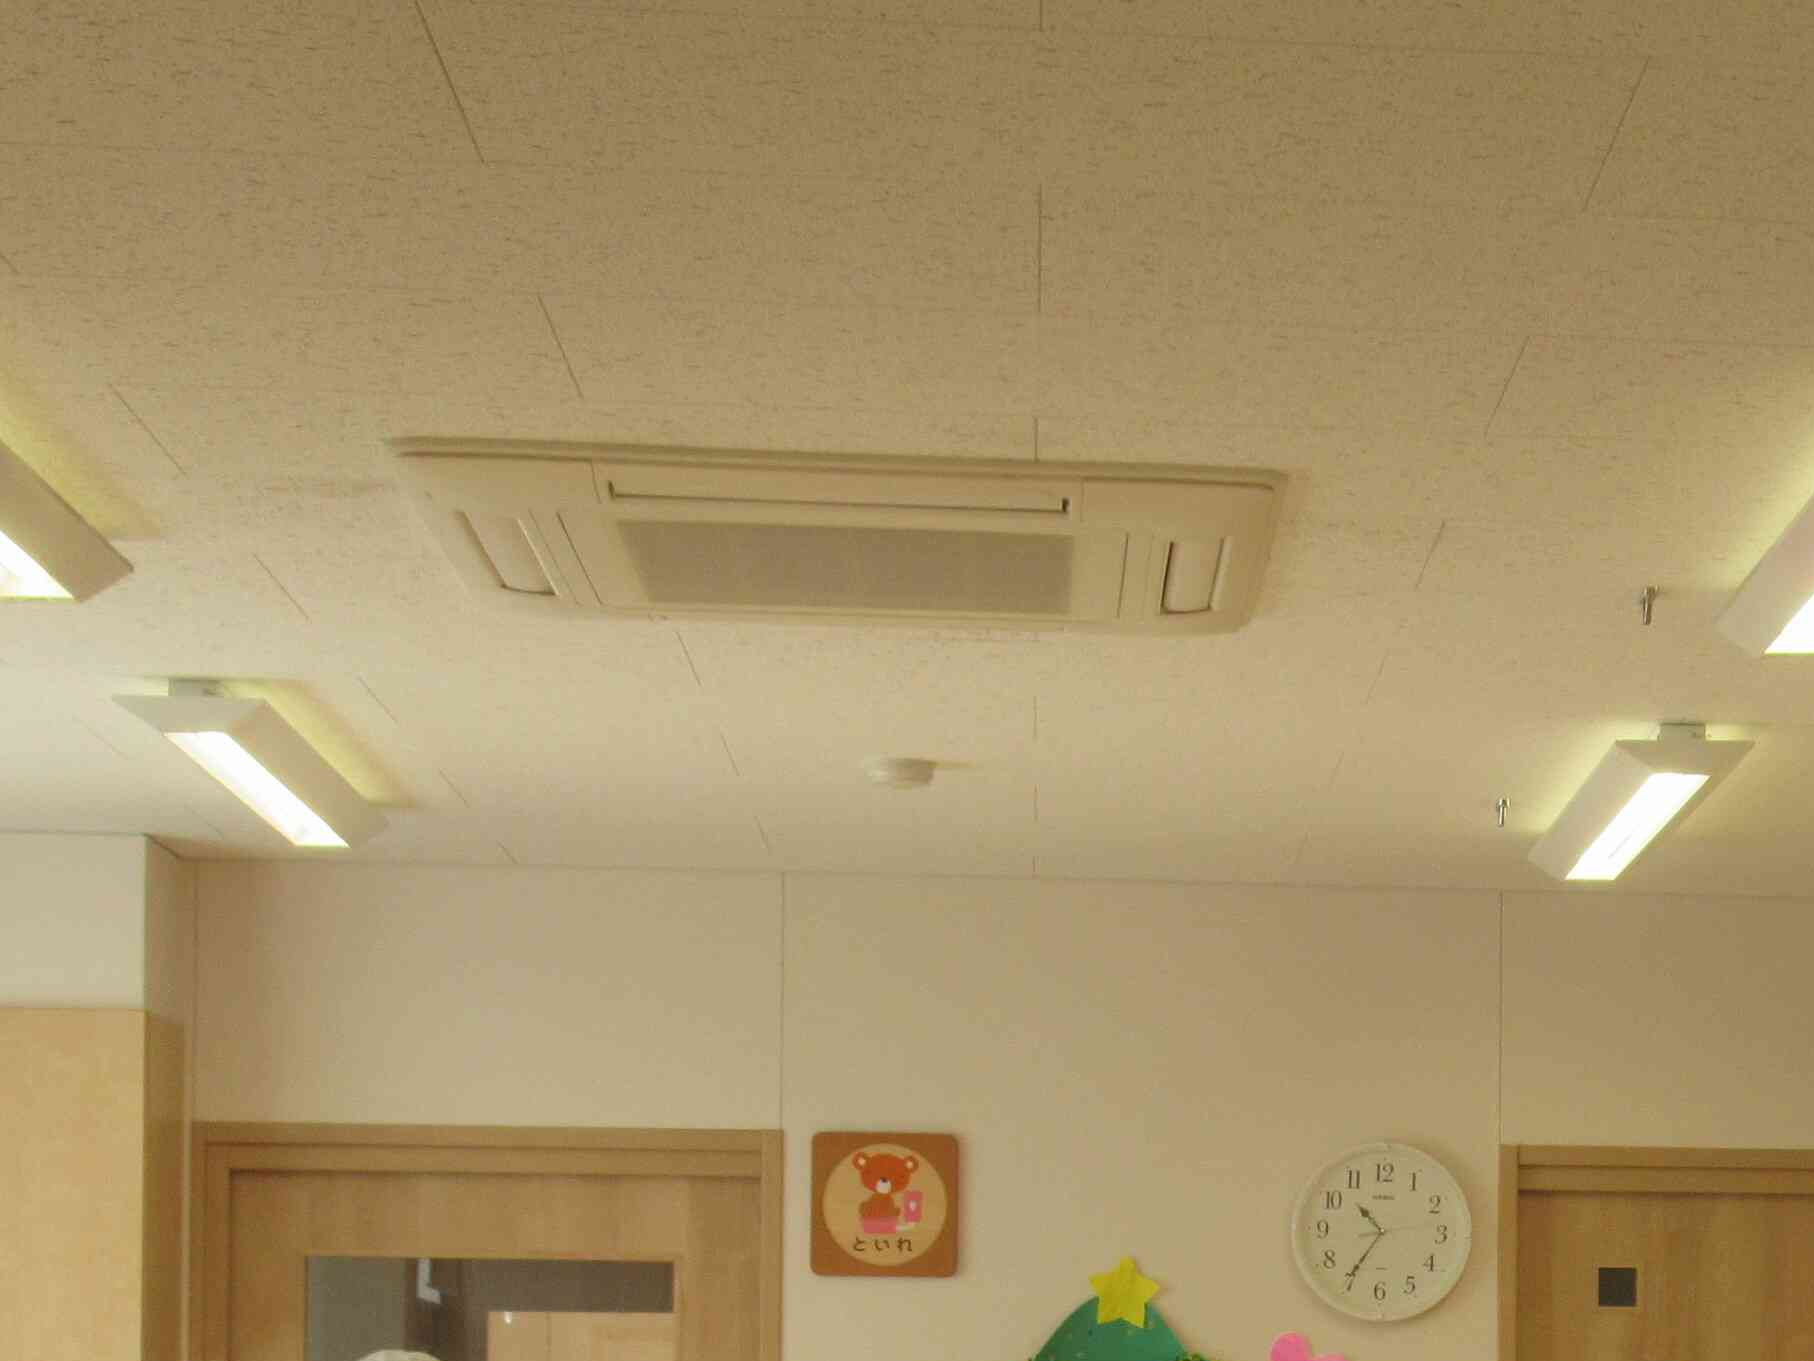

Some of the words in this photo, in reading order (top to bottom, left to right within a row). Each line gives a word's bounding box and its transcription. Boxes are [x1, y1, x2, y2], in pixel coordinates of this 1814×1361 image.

[1347, 1170, 1361, 1189] 11
[1375, 1163, 1394, 1183] 12
[1409, 1172, 1417, 1191] 1
[1324, 1190, 1342, 1210] 10
[1428, 1195, 1441, 1214] 2
[1316, 1219, 1329, 1239] 9
[1434, 1224, 1448, 1244] 3
[853, 1237, 913, 1253] といれ
[1323, 1249, 1336, 1269] 8
[1423, 1254, 1436, 1272] 4
[1374, 1281, 1387, 1301] 6
[1403, 1275, 1416, 1295] 5
